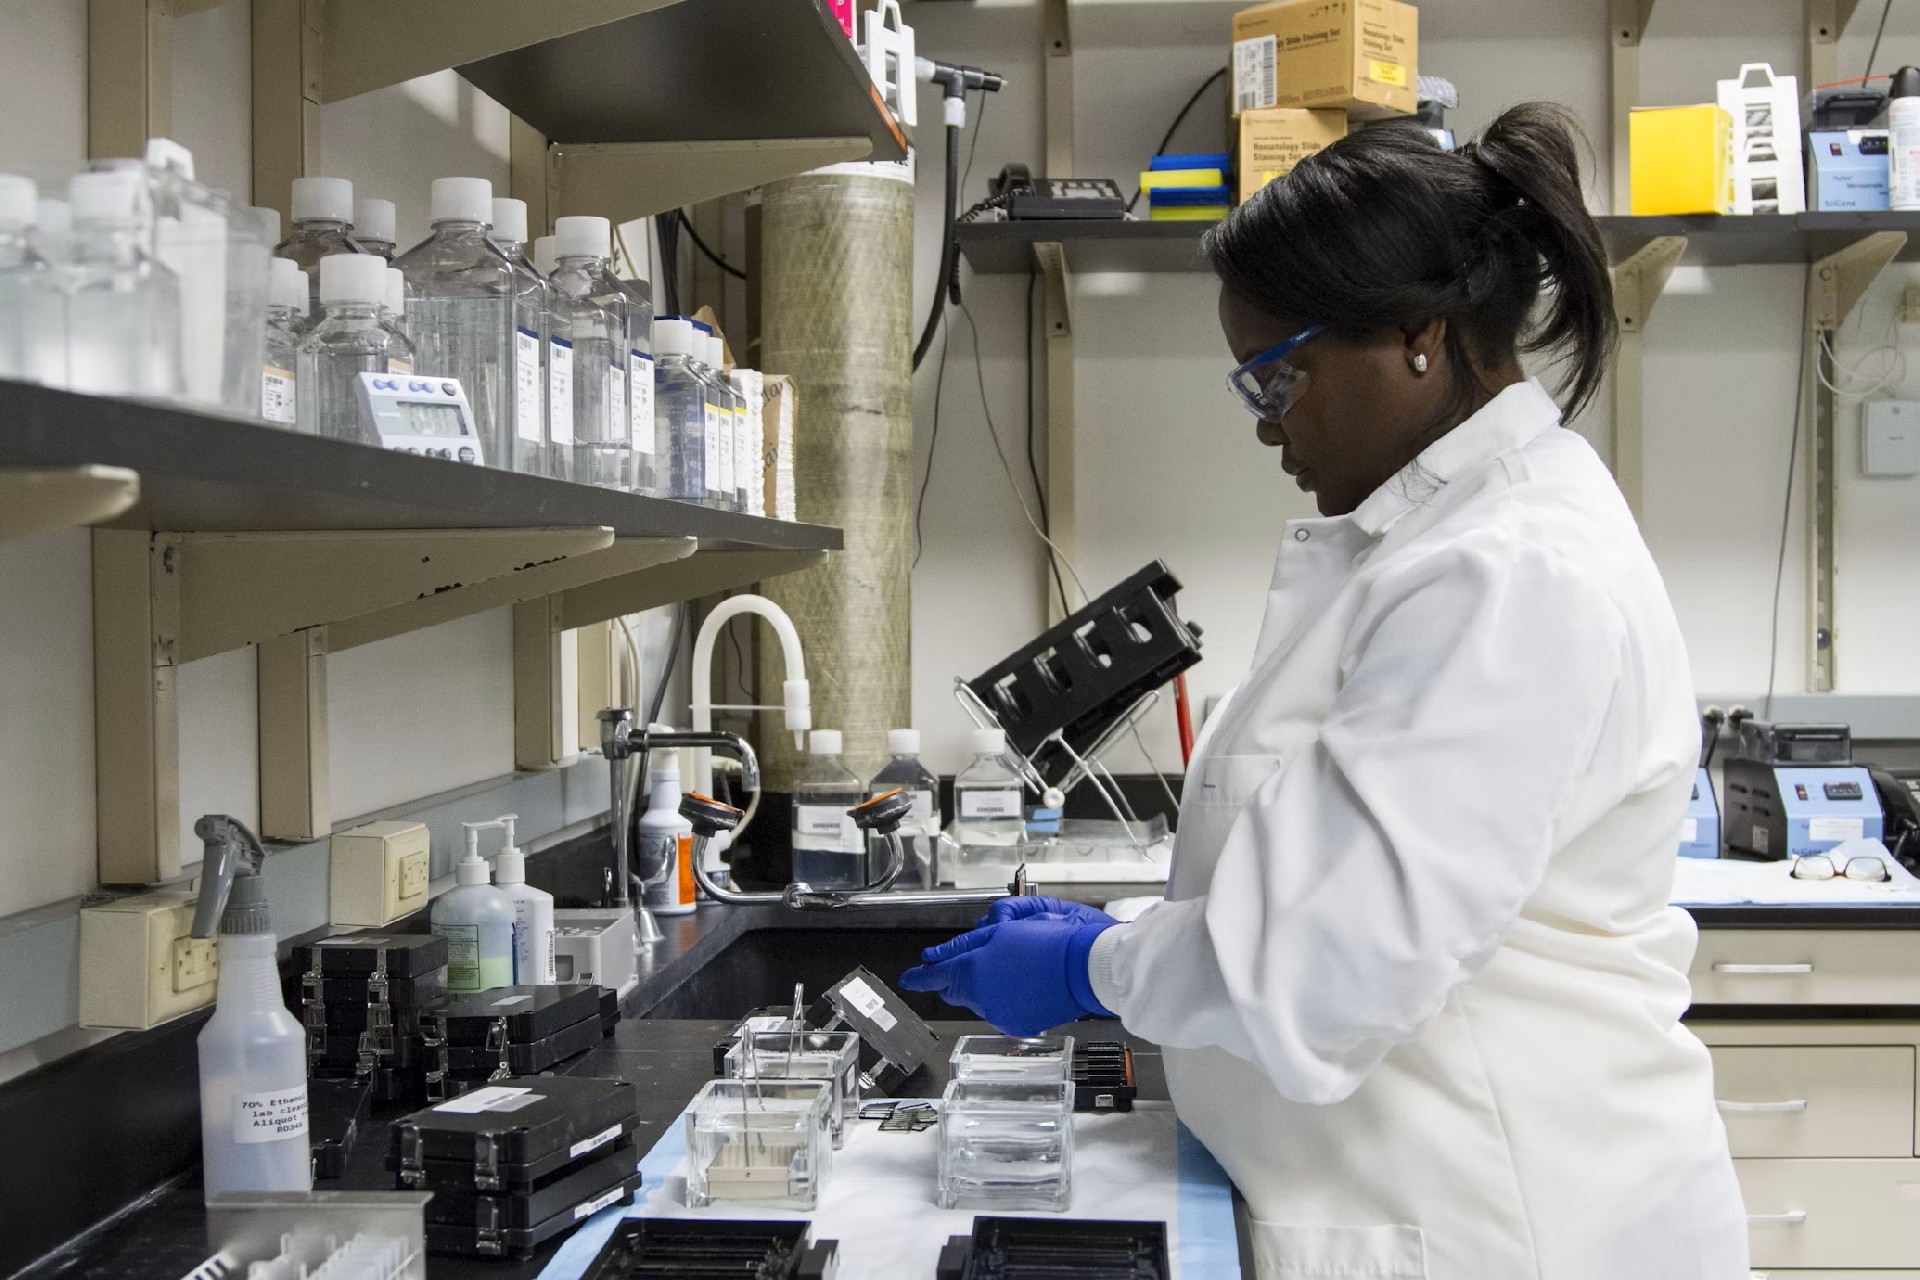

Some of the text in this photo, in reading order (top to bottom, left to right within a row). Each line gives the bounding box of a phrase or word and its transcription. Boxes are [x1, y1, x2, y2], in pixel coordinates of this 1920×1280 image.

[1254, 141, 1321, 152] Hematology Slide
[1253, 153, 1286, 163] Staining
[242, 1101, 263, 1109] 70%
[253, 1115, 296, 1126] Aliquot
